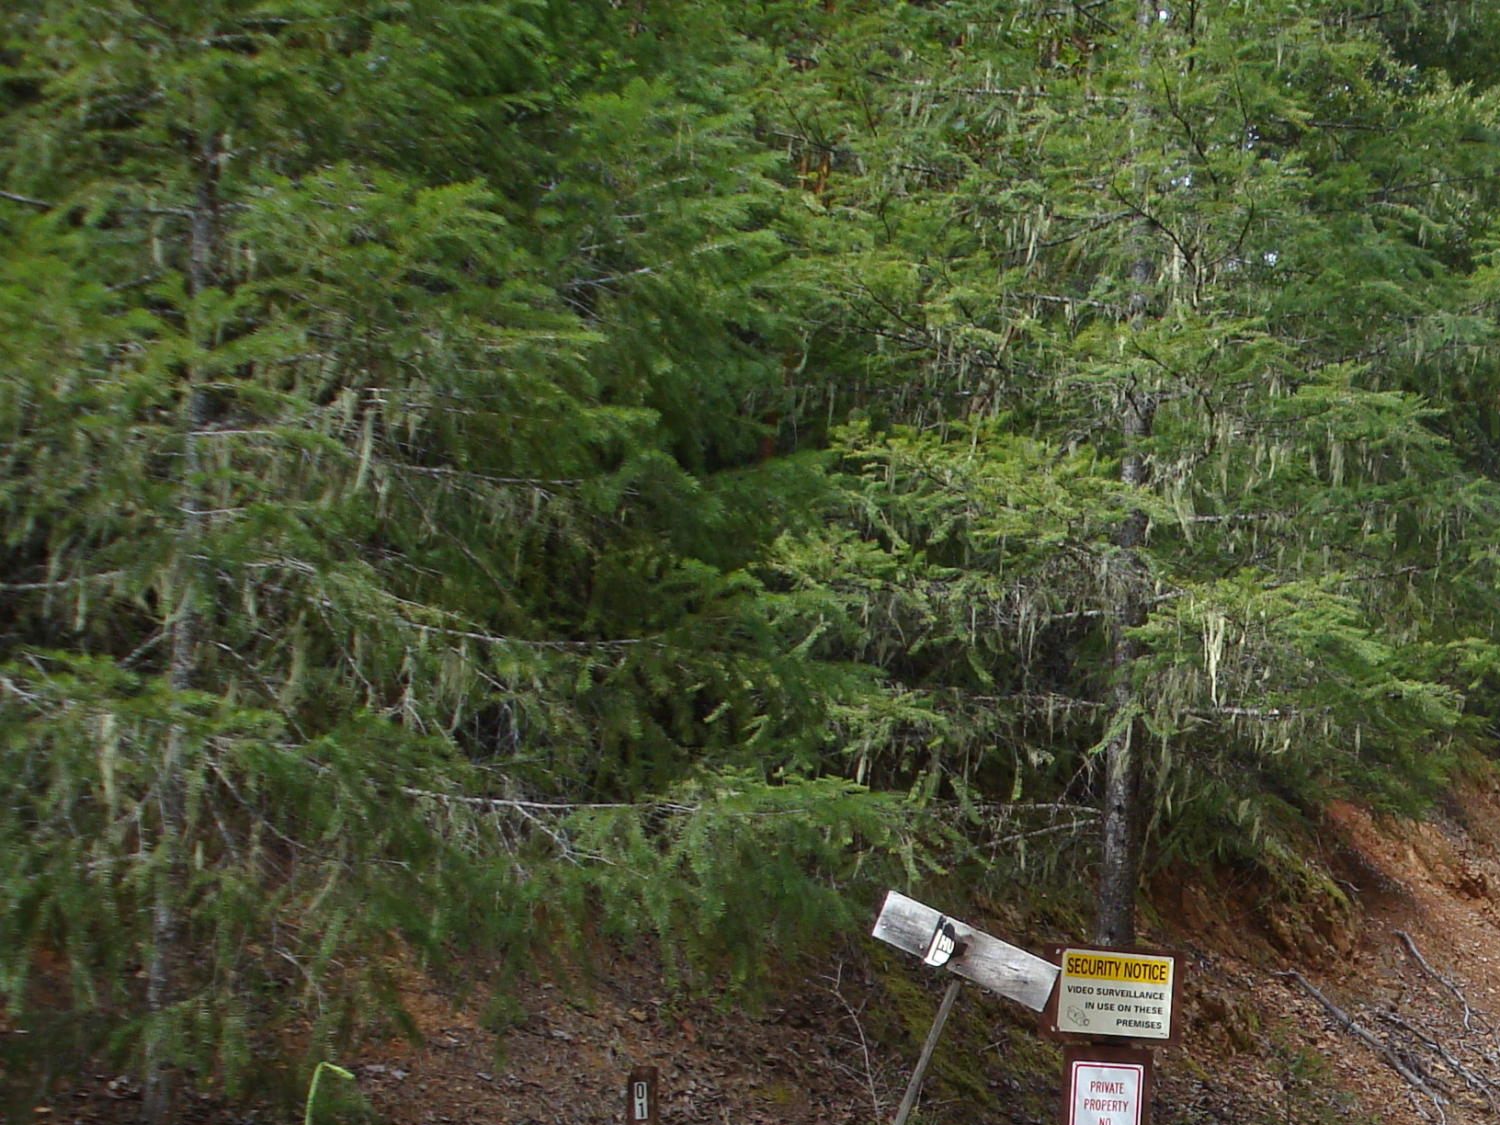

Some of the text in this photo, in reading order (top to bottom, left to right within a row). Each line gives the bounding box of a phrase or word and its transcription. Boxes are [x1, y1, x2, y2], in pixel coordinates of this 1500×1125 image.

[1067, 957, 1167, 981] SECURITY NOTICE
[1067, 985, 1165, 1000] VIDEO SURVEILLANCE
[1084, 1001, 1164, 1015] IN USE ON THESE
[1115, 1018, 1162, 1030] PREMISES
[1090, 1081, 1125, 1094] PRIVATE
[1084, 1098, 1129, 1112] PROPERTY
